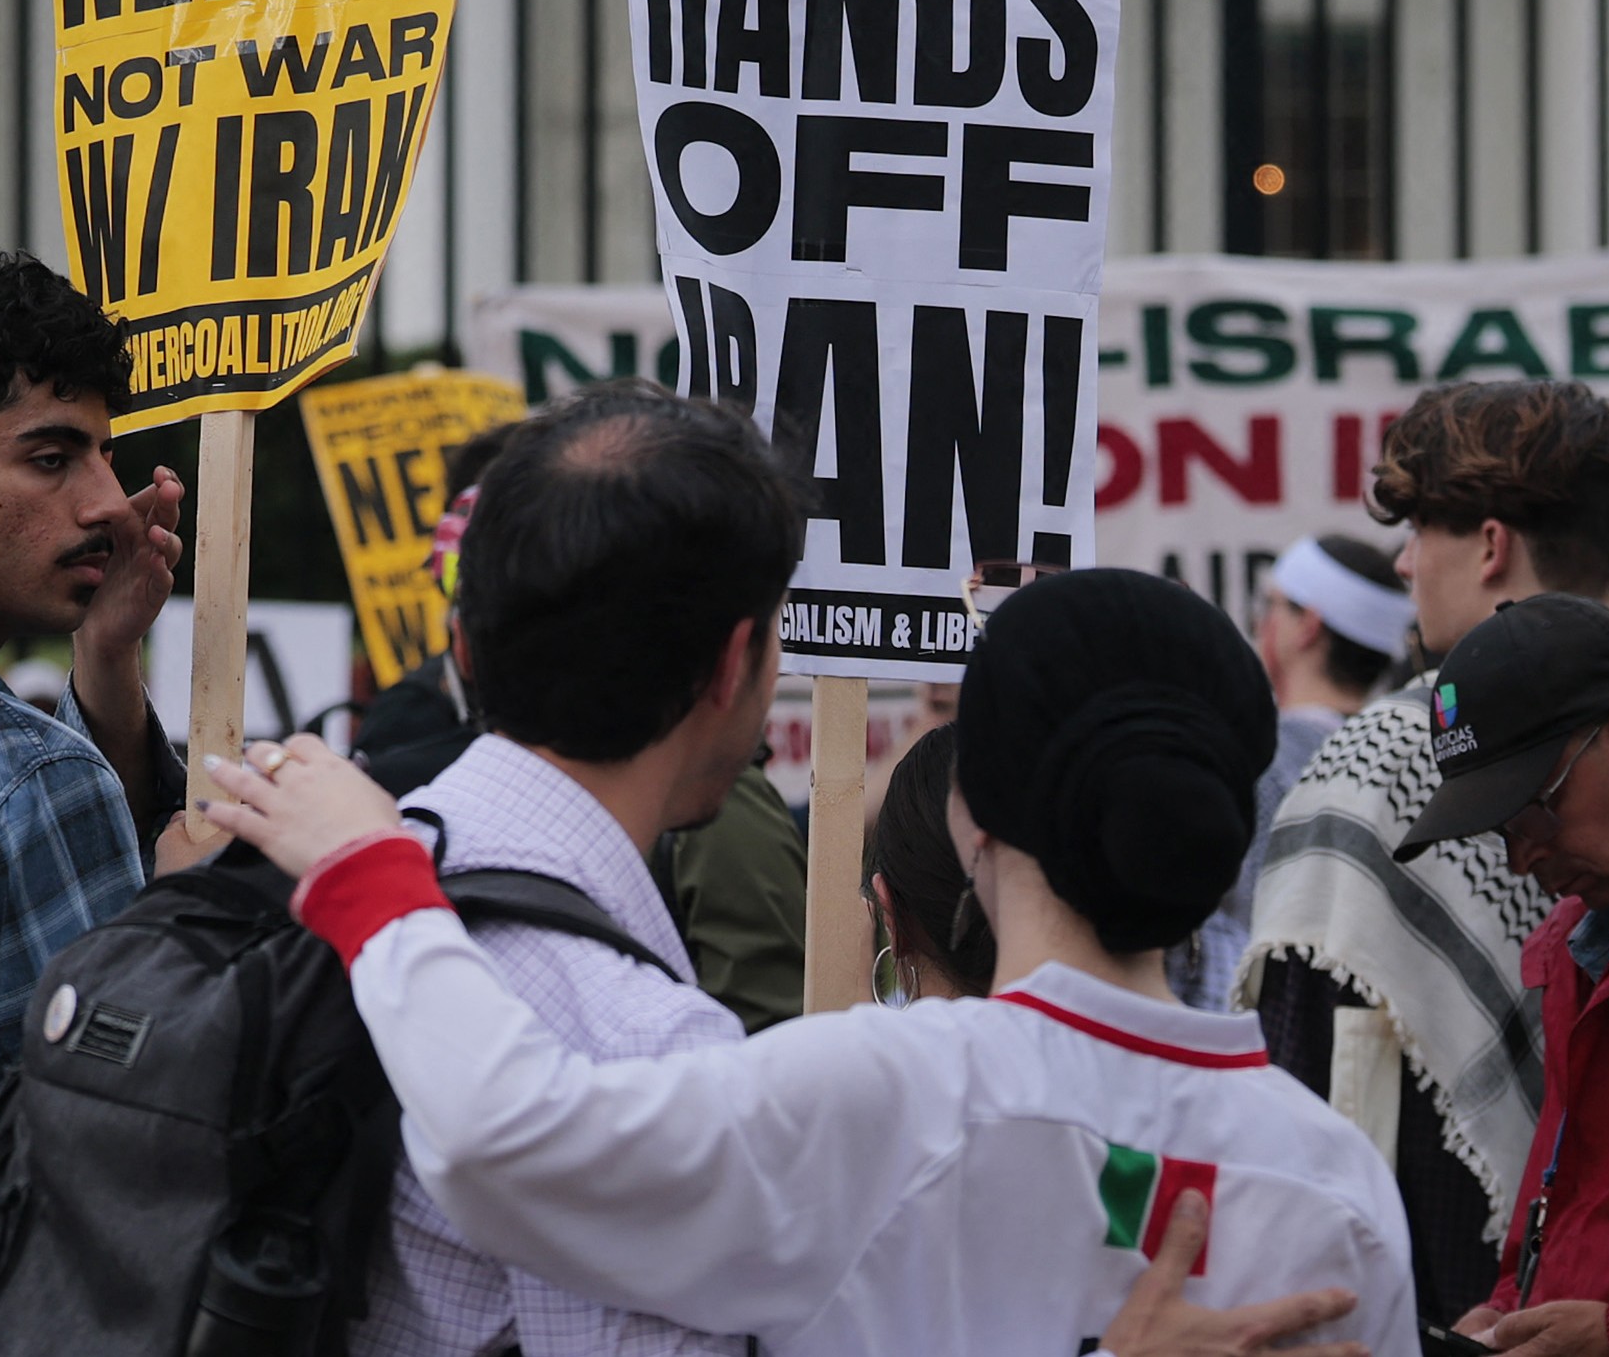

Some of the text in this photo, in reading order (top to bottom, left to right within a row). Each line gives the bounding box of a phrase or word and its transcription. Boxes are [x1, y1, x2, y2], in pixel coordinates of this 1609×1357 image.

[64, 11, 439, 134] NOT WAR
[66, 83, 426, 305] W/ IRAN
[654, 100, 1094, 272] OFF
[127, 274, 368, 396] WERCOALITION.ORG
[778, 601, 882, 647] CIALISM
[891, 612, 913, 649] &
